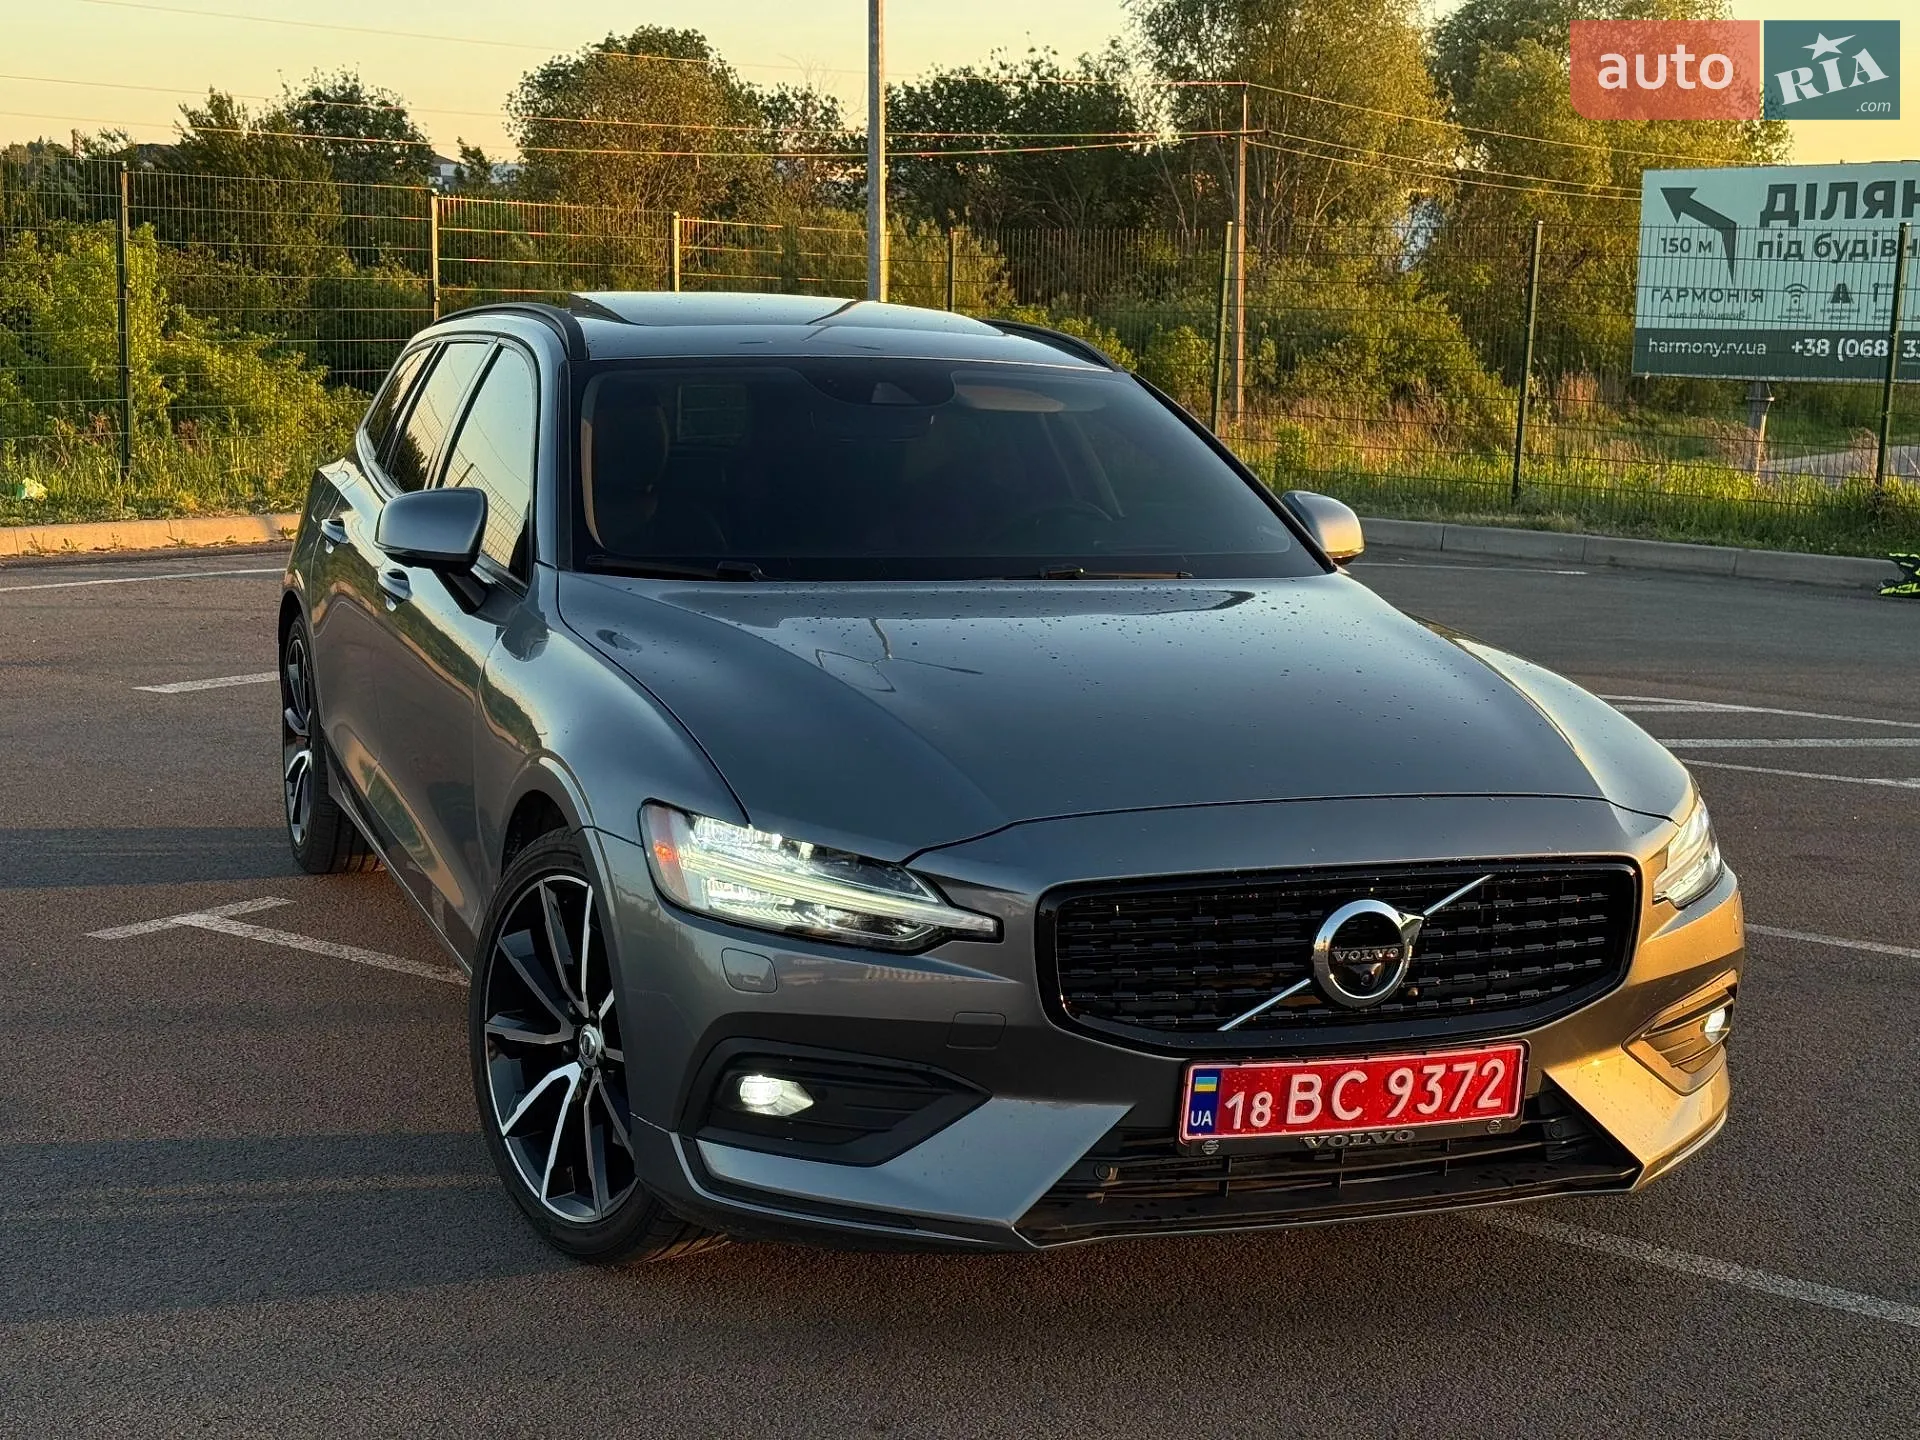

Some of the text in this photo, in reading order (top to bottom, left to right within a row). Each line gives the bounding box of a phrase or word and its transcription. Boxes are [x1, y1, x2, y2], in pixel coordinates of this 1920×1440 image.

[1660, 237, 1692, 255] 150
[1757, 232, 1804, 261] під
[1651, 287, 1764, 304] ГАРМОНІЯ
[1648, 337, 1767, 358] harmony.rv.ua
[1791, 338, 1831, 357] +38
[1332, 947, 1399, 962] VOLVO
[1224, 1058, 1506, 1130] 18 BC 9372
[1190, 1110, 1213, 1127] UA
[1301, 1129, 1416, 1149] VOLVO
